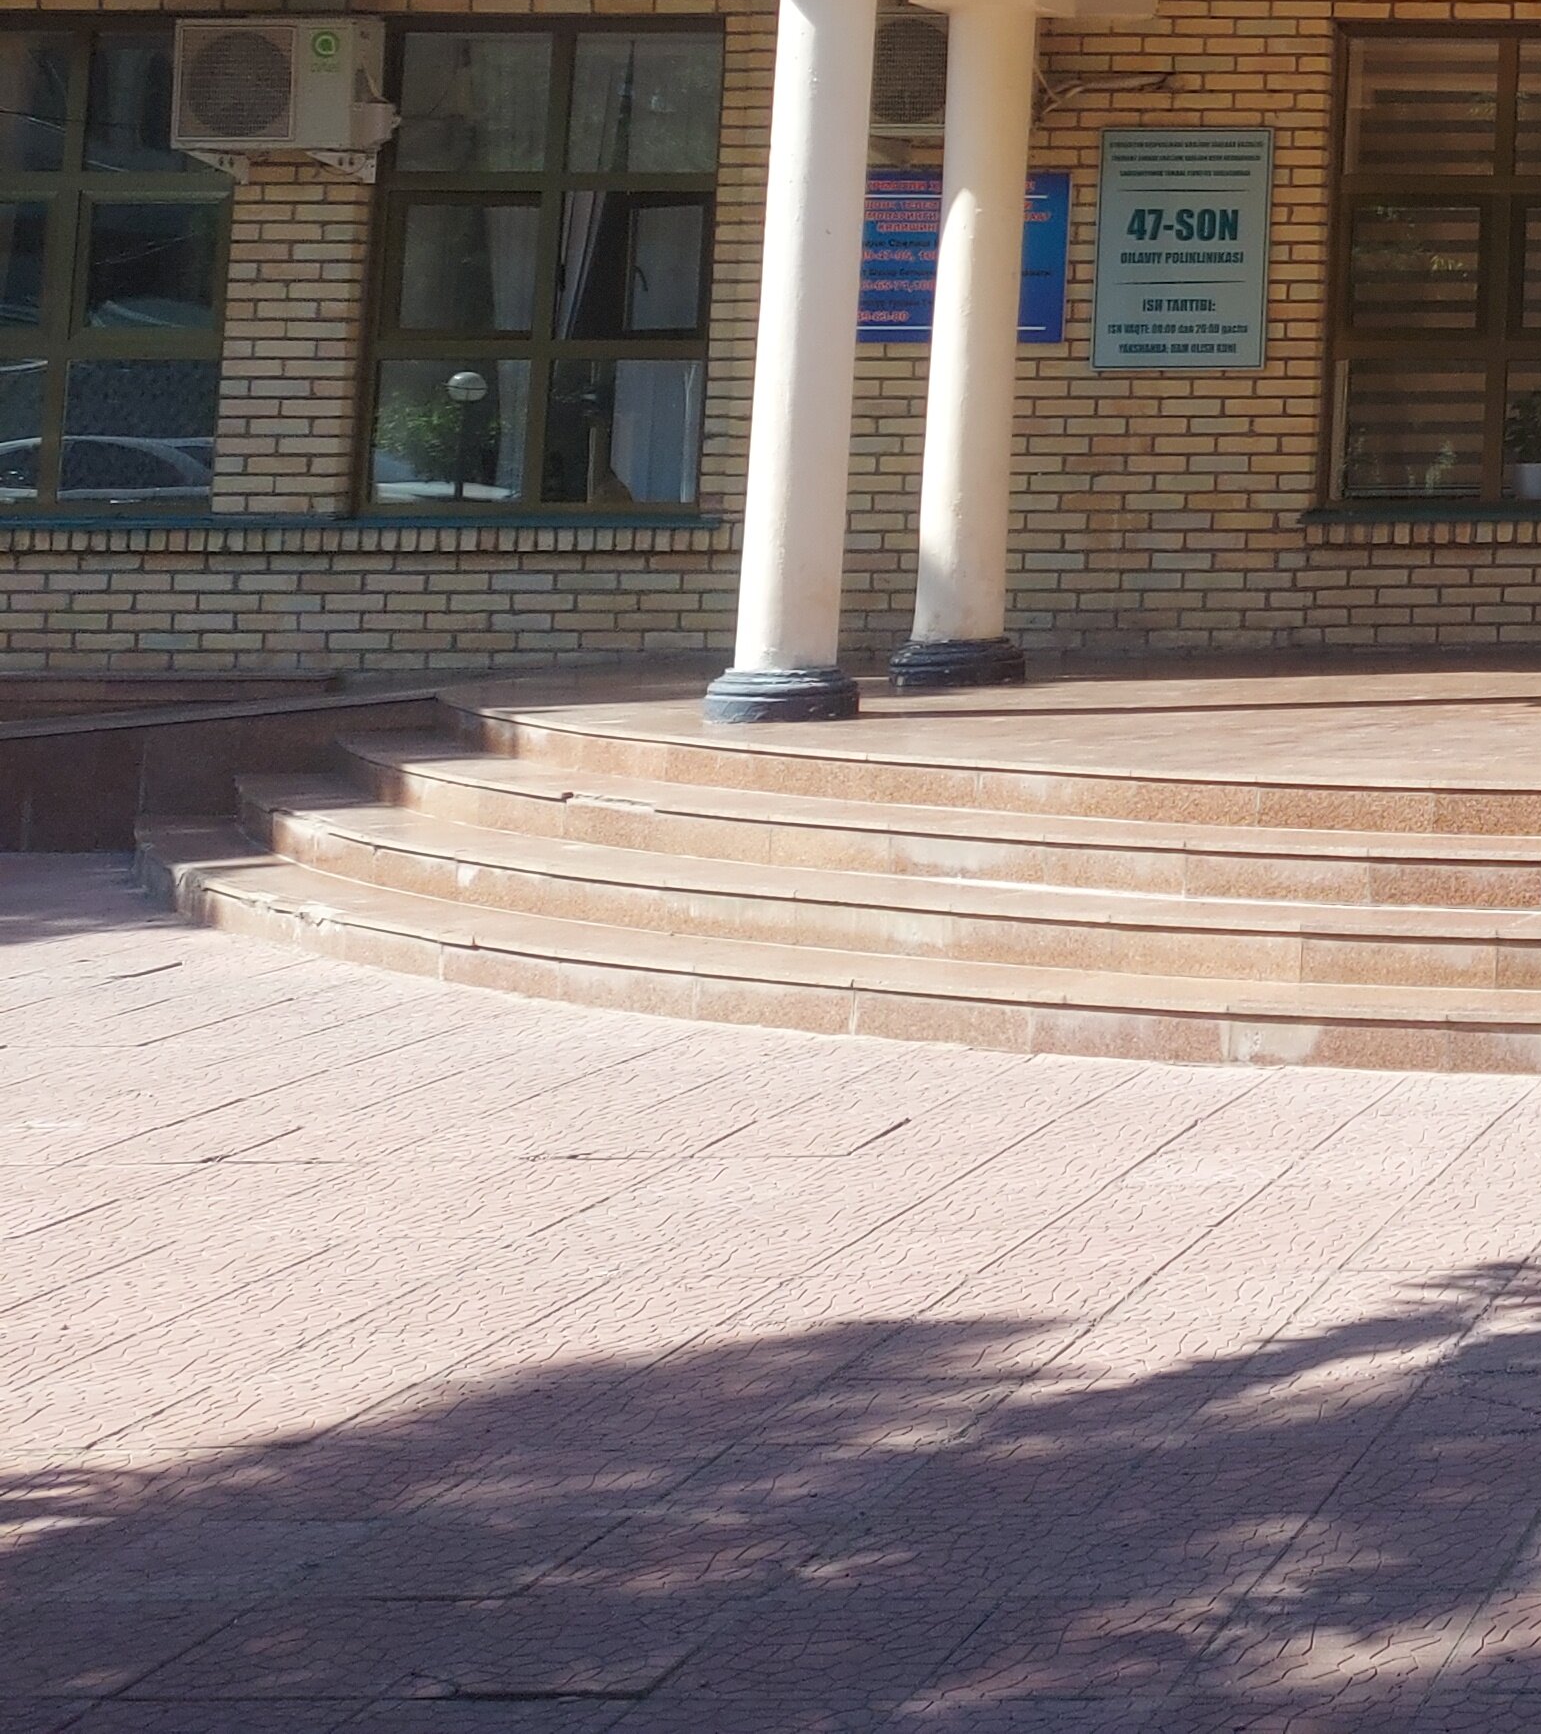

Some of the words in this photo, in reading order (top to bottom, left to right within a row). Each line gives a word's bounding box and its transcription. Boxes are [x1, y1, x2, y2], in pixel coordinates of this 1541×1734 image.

[1126, 208, 1240, 242] 47-SON
[1165, 251, 1244, 264] POLIKLINIKASI
[1142, 299, 1163, 312] ISH
